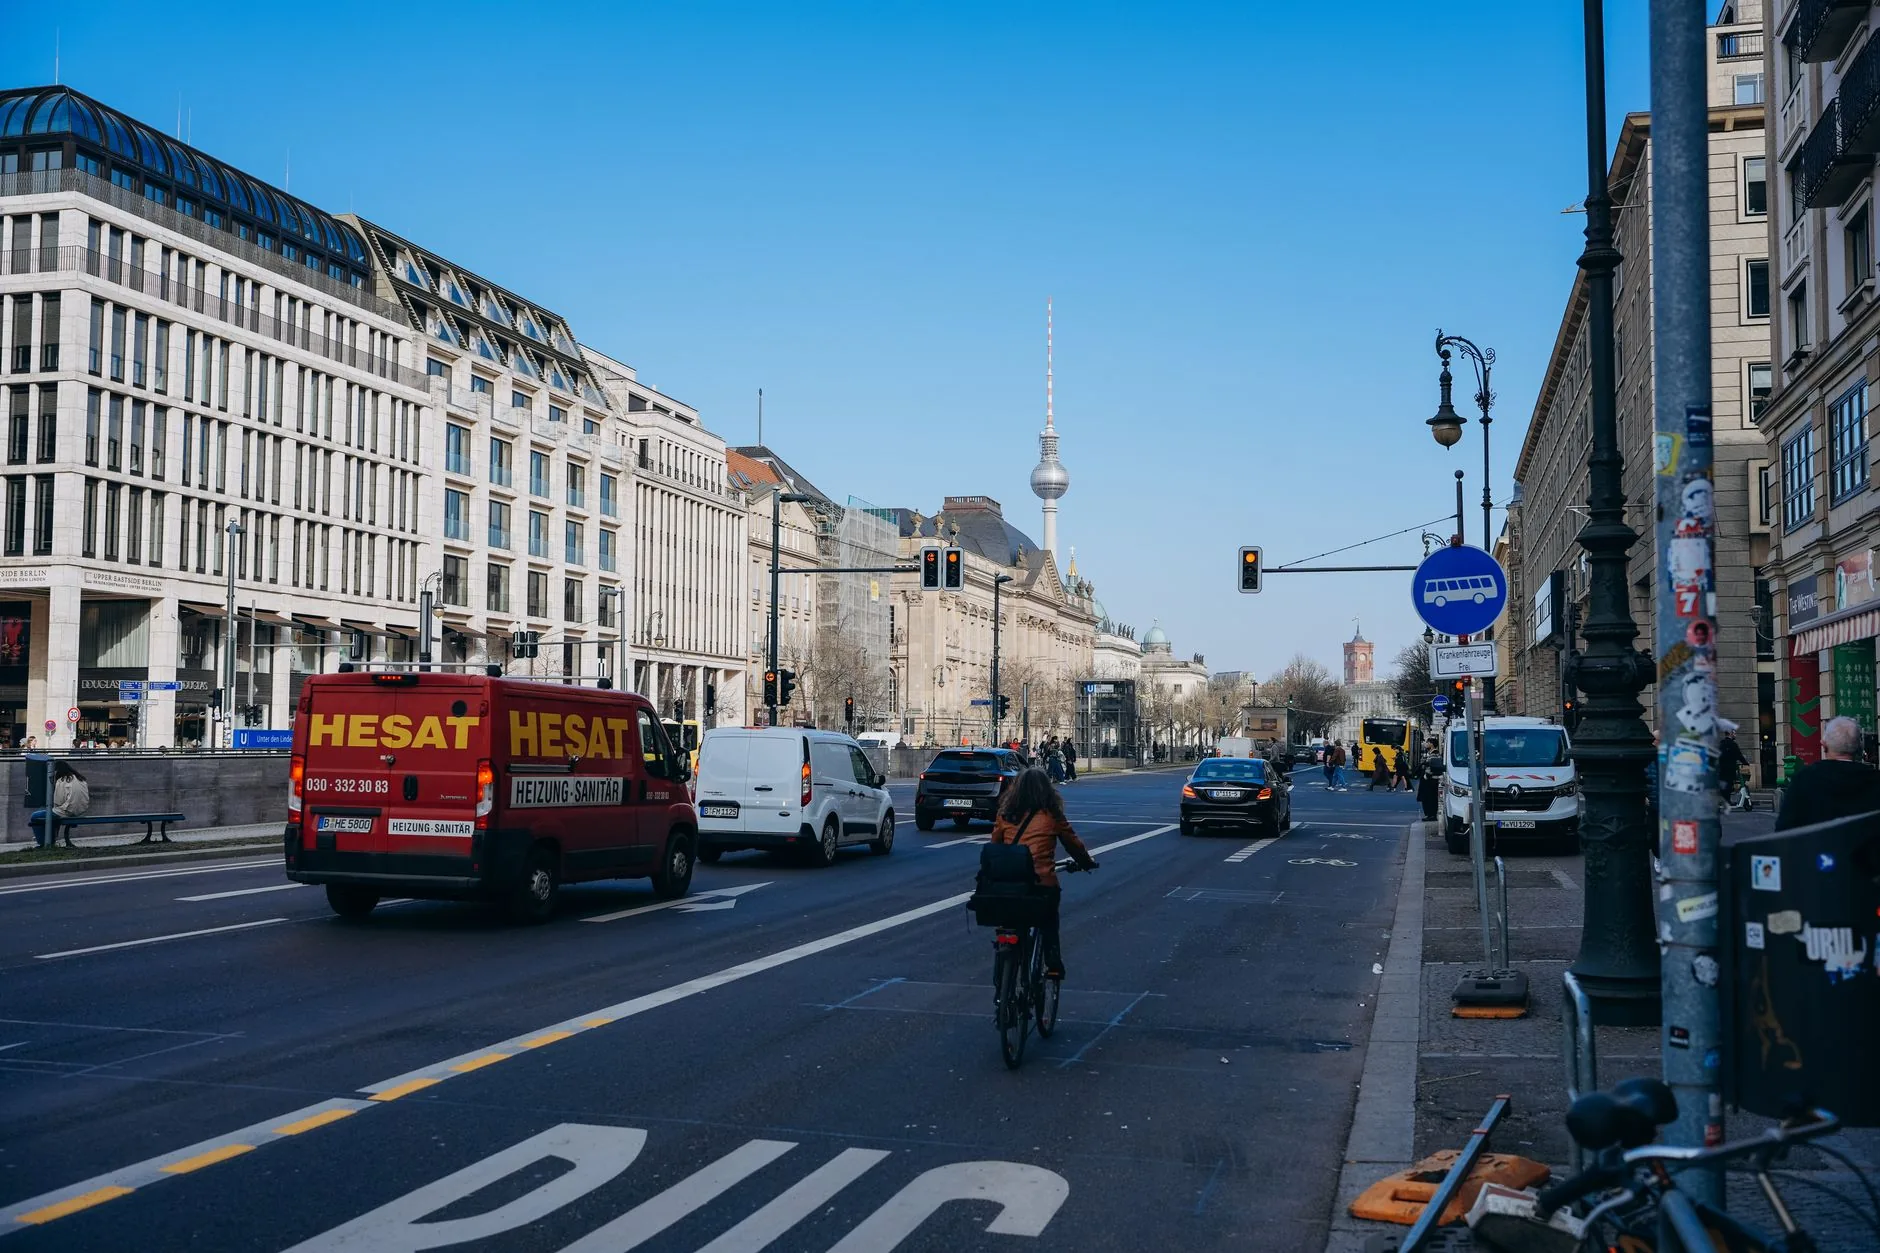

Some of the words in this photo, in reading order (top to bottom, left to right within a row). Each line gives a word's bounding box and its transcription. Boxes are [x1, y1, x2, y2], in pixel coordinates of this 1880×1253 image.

[93, 573, 112, 581] UPPER
[113, 576, 141, 585] EASTSIDE
[1680, 592, 1697, 613] 7
[1439, 649, 1491, 660] Krankenfahrzeuge
[1458, 662, 1471, 671] Frei
[82, 680, 120, 689] DOUGLAS
[1087, 684, 1094, 692] U
[70, 710, 78, 718] 30
[310, 713, 480, 750] HESAT
[509, 710, 628, 760] HESAT
[240, 733, 247, 744] U
[257, 735, 270, 743] Unter
[280, 735, 293, 743] Linde
[306, 778, 327, 791] 030
[335, 779, 356, 792] 332
[358, 780, 372, 793] 30
[375, 780, 388, 793] 83
[324, 818, 329, 828] B
[335, 818, 346, 829] HE
[348, 818, 370, 830] 5800
